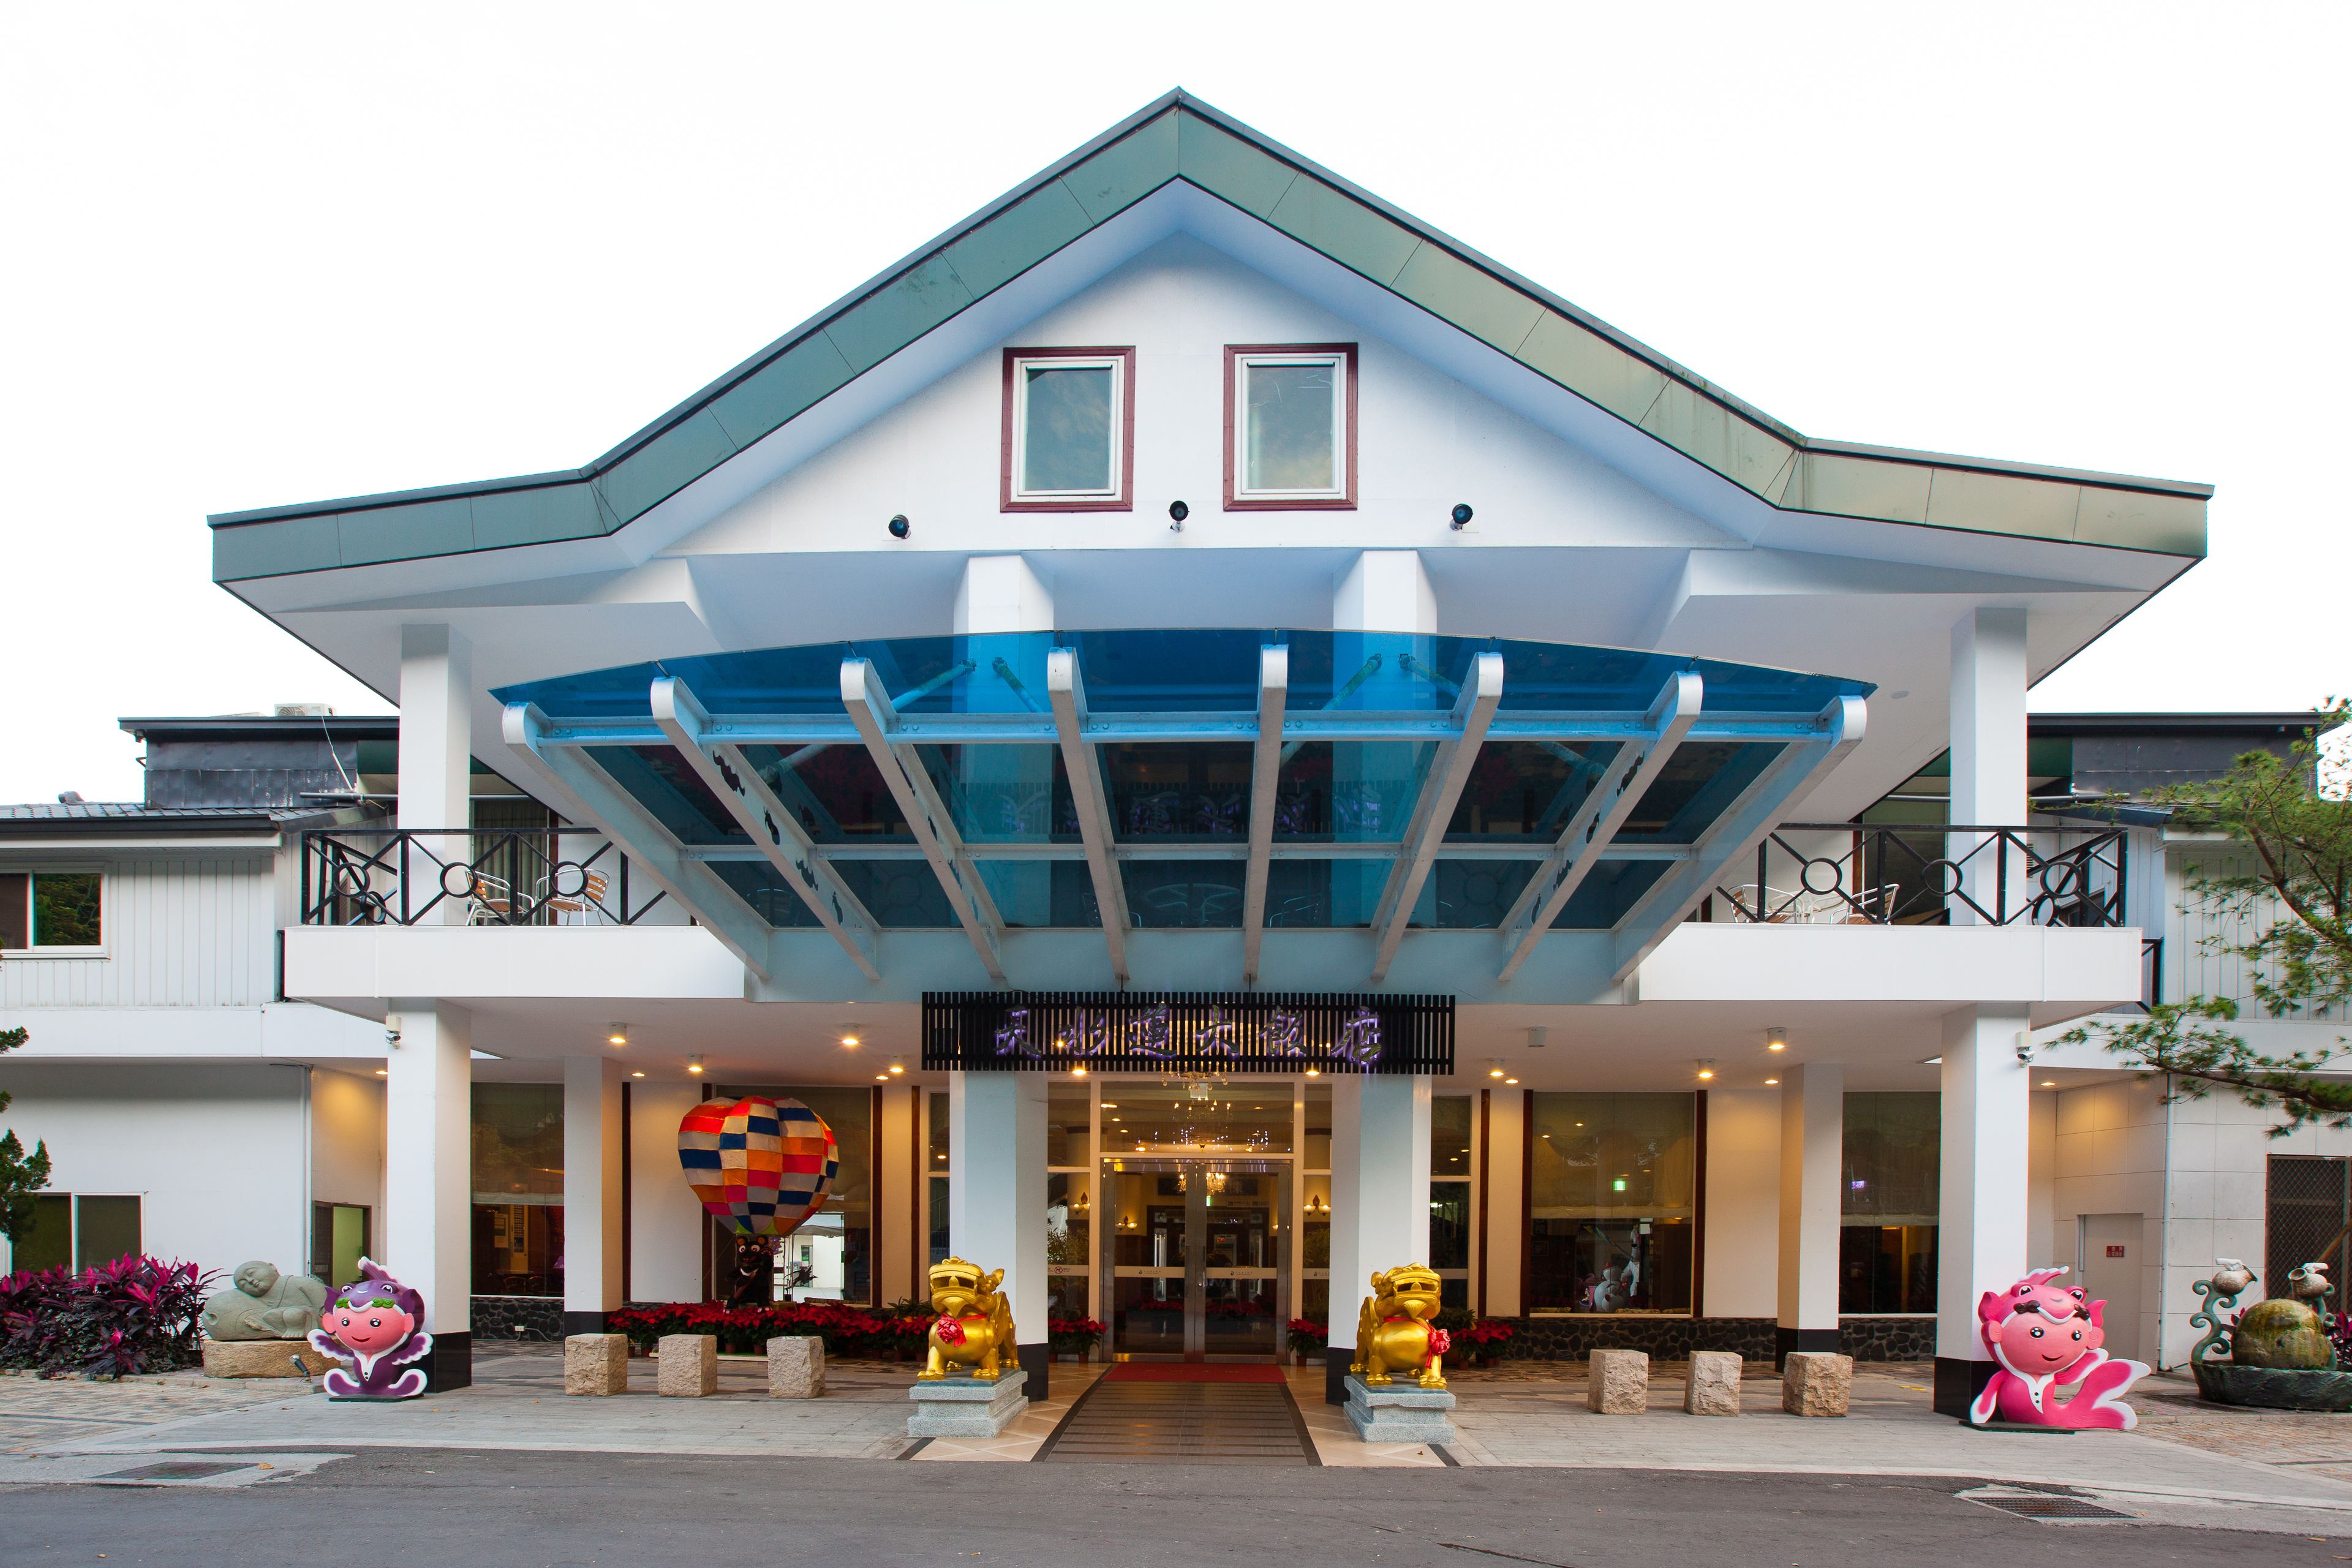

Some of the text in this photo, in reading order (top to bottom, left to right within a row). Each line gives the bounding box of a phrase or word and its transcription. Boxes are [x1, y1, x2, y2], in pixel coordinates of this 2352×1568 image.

[992, 1002, 1382, 1063] 天水蓮大飯店
